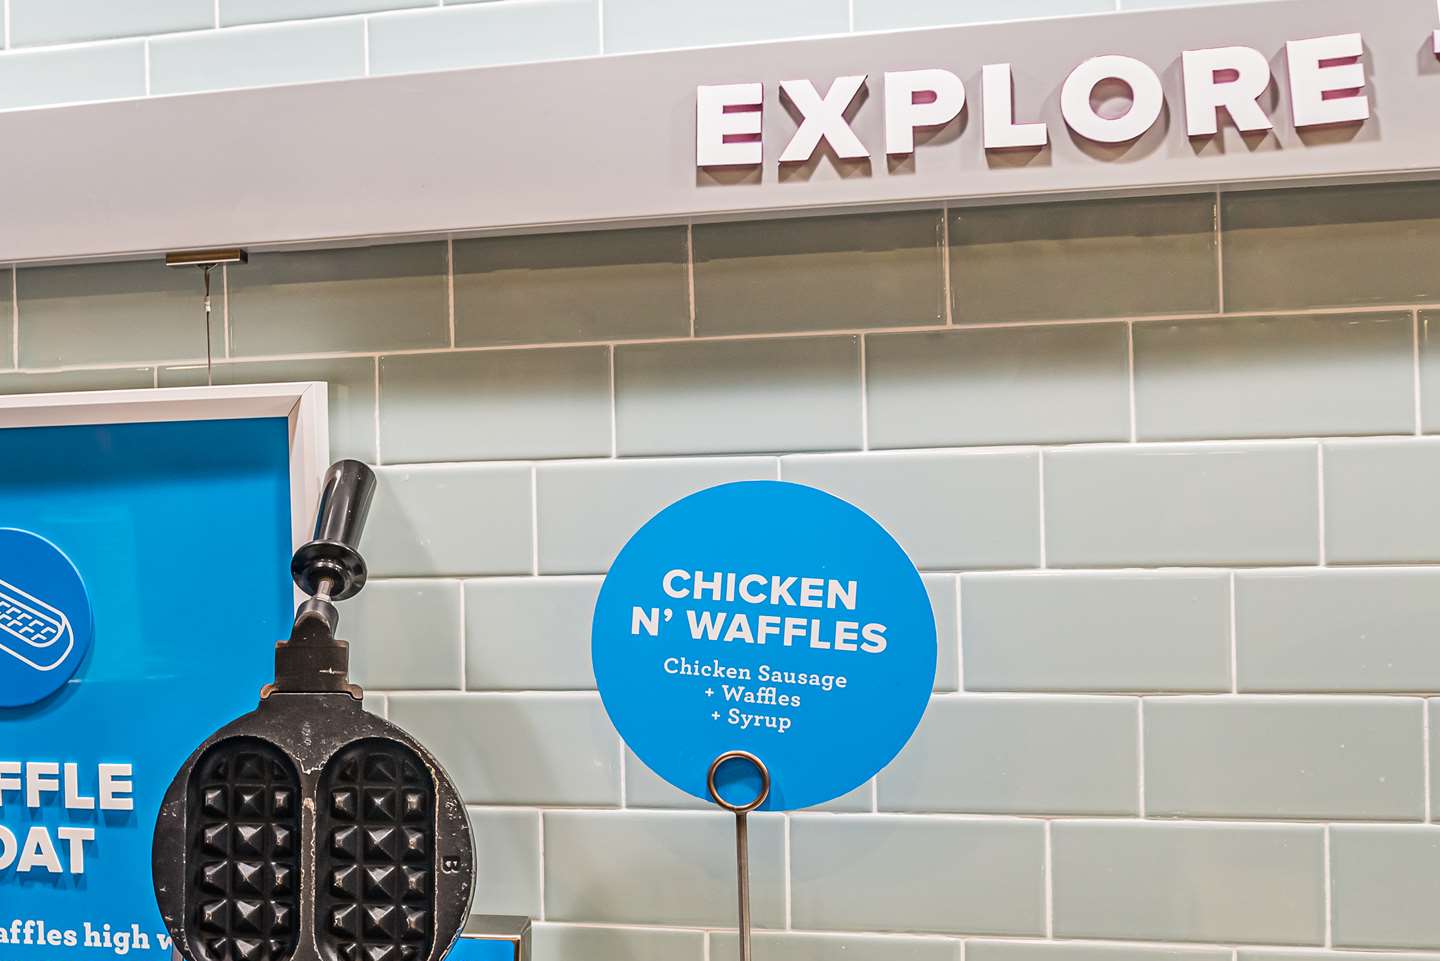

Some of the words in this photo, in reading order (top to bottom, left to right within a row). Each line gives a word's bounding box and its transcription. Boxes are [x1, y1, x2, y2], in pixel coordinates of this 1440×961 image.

[696, 33, 1370, 167] EXPLORE
[662, 569, 858, 611] CHICKEN
[686, 610, 888, 653] WAFFLES
[663, 657, 751, 681] Chicken
[758, 665, 848, 690] Sausage
[705, 688, 714, 697] +
[722, 685, 801, 707] Waffles
[711, 711, 721, 721] +
[727, 708, 792, 732] Syrup
[84, 922, 150, 955] high
